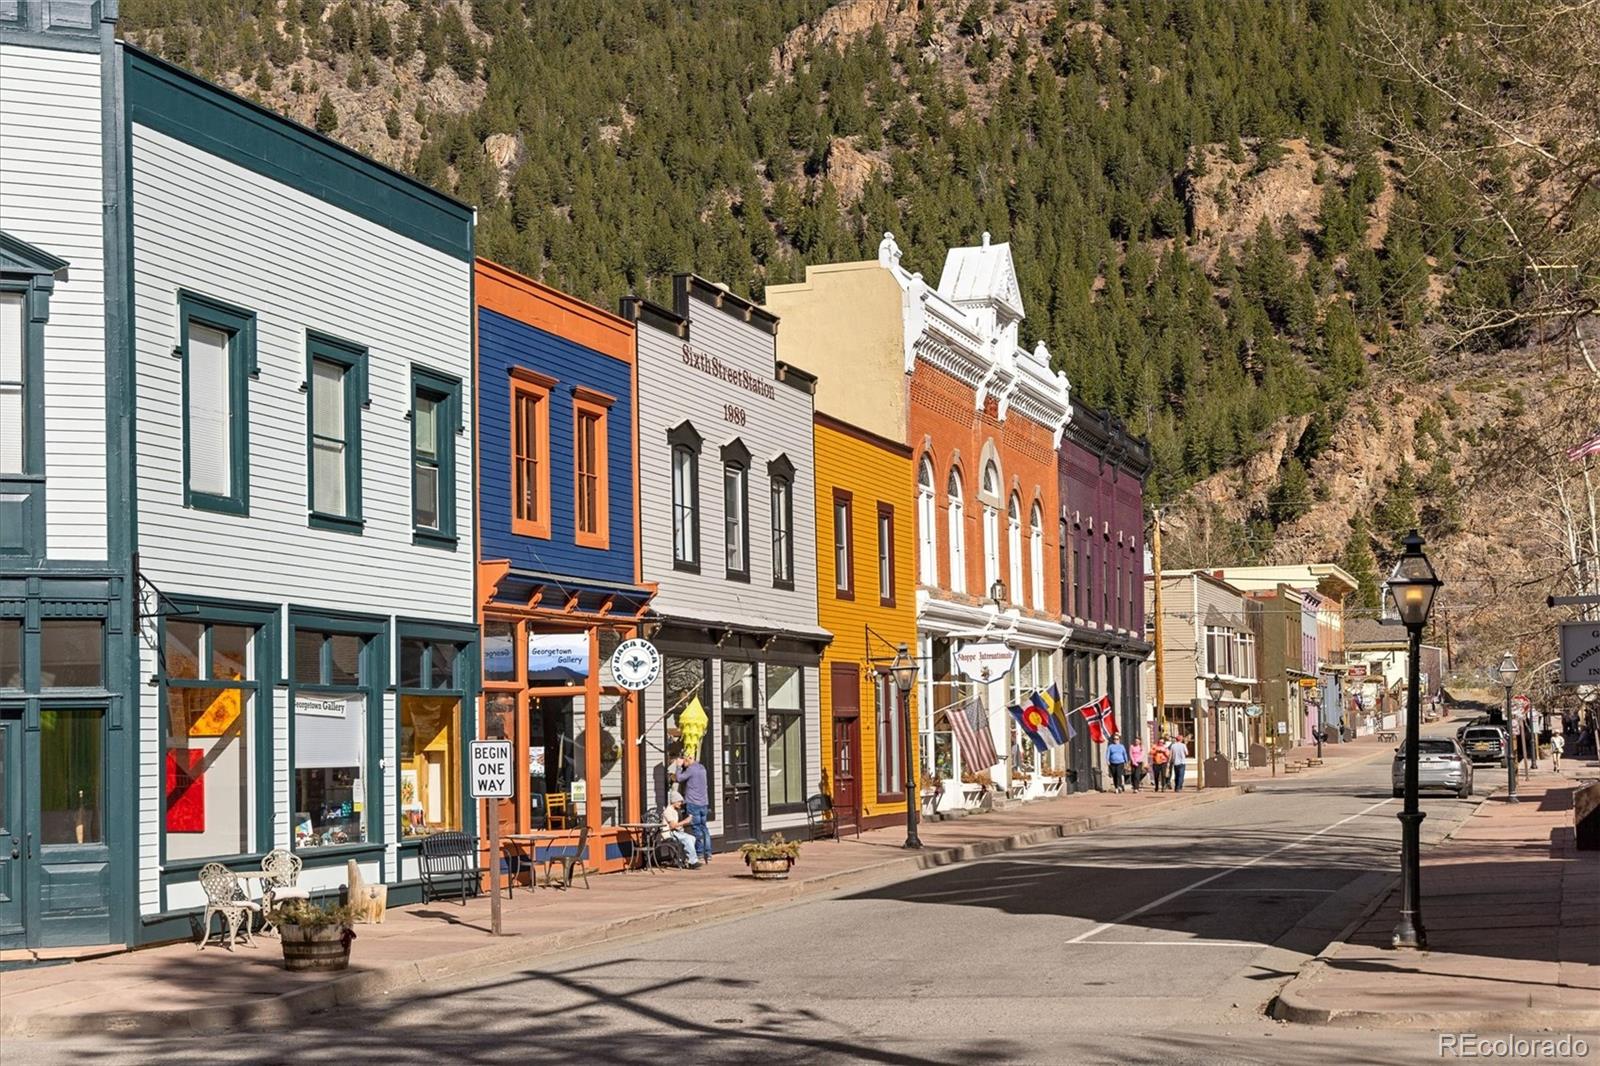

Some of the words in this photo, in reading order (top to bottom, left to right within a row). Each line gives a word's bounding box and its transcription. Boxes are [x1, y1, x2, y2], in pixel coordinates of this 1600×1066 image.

[531, 648, 572, 656] Georgetown
[640, 641, 658, 664] VISA
[557, 656, 583, 664] Gallery
[616, 673, 655, 688] COFFEE
[322, 701, 345, 713] Gallery
[474, 747, 508, 759] BEGIN
[478, 763, 505, 775] ONE
[478, 779, 505, 791] WAY
